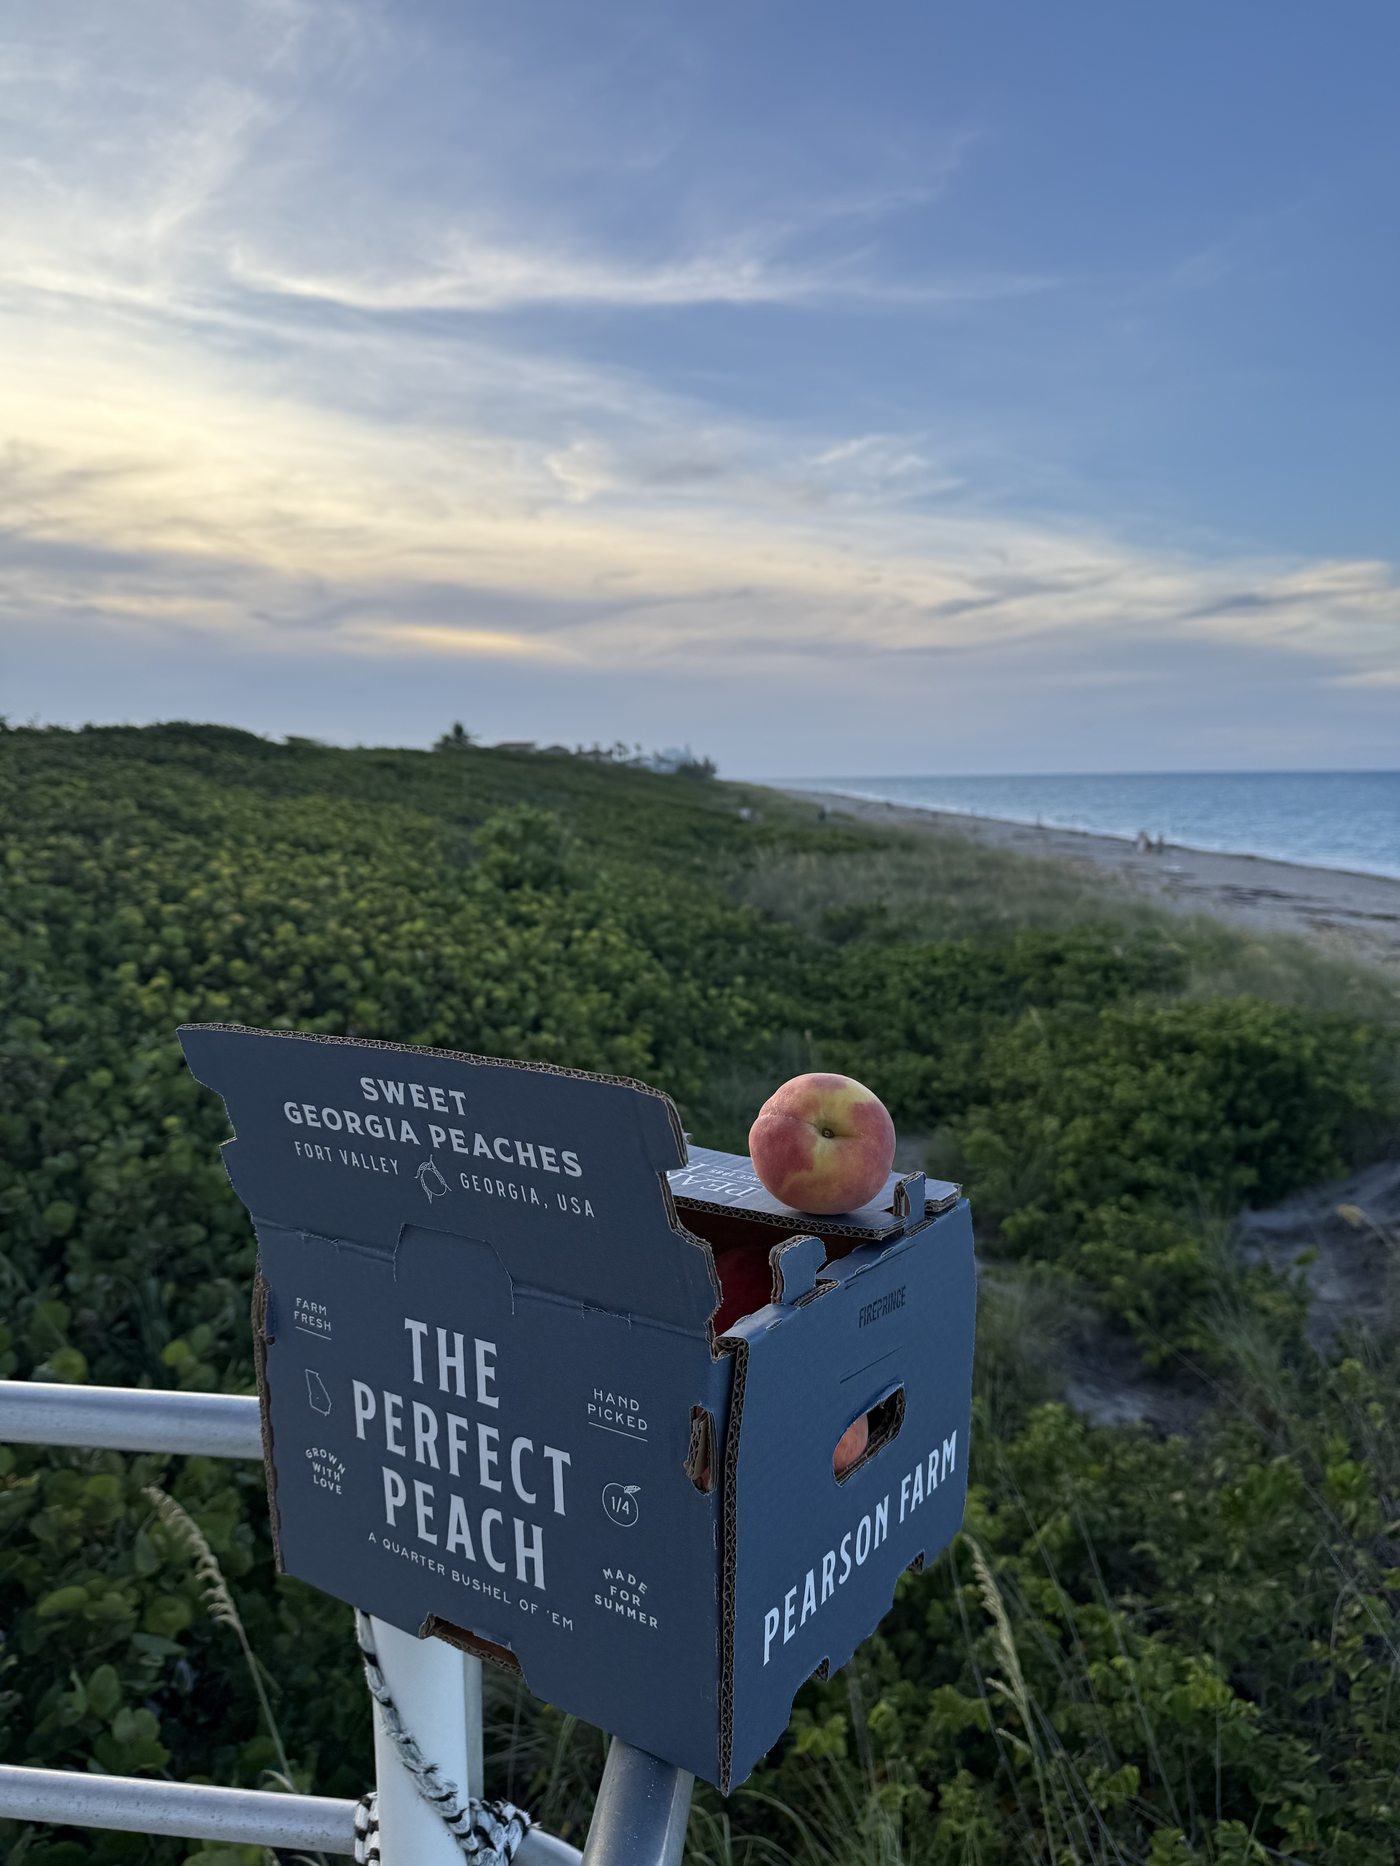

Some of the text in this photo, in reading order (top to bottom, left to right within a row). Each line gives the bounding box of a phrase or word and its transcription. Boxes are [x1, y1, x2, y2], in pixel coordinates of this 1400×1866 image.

[360, 1076, 467, 1116] SWEET
[283, 1101, 583, 1178] GEORGIA PEACHES
[294, 1140, 399, 1175] FORT VALLEY
[459, 1172, 595, 1218] GEORGIA, USA
[293, 1310, 332, 1332] FRESH
[296, 1297, 327, 1316] FARM
[858, 1286, 906, 1328] FIREPRINCE
[404, 1317, 500, 1409] THE
[587, 1402, 648, 1431] PICKED
[593, 1388, 640, 1412] HAND
[305, 1447, 346, 1475] GROWN
[352, 1379, 572, 1517] PERFECT
[312, 1461, 341, 1482] WITH
[313, 1474, 342, 1495] LOVE
[611, 1496, 630, 1515] 1/4
[381, 1466, 546, 1591] PEACH
[763, 1429, 957, 1666] PEARSON FARM
[368, 1531, 377, 1544] A
[382, 1538, 445, 1576] QUARTER
[451, 1569, 512, 1605] BUSHEL
[519, 1598, 539, 1614] OF
[602, 1568, 648, 1595] MADE
[594, 1594, 658, 1629] SUMMER
[610, 1585, 641, 1607] FOR
